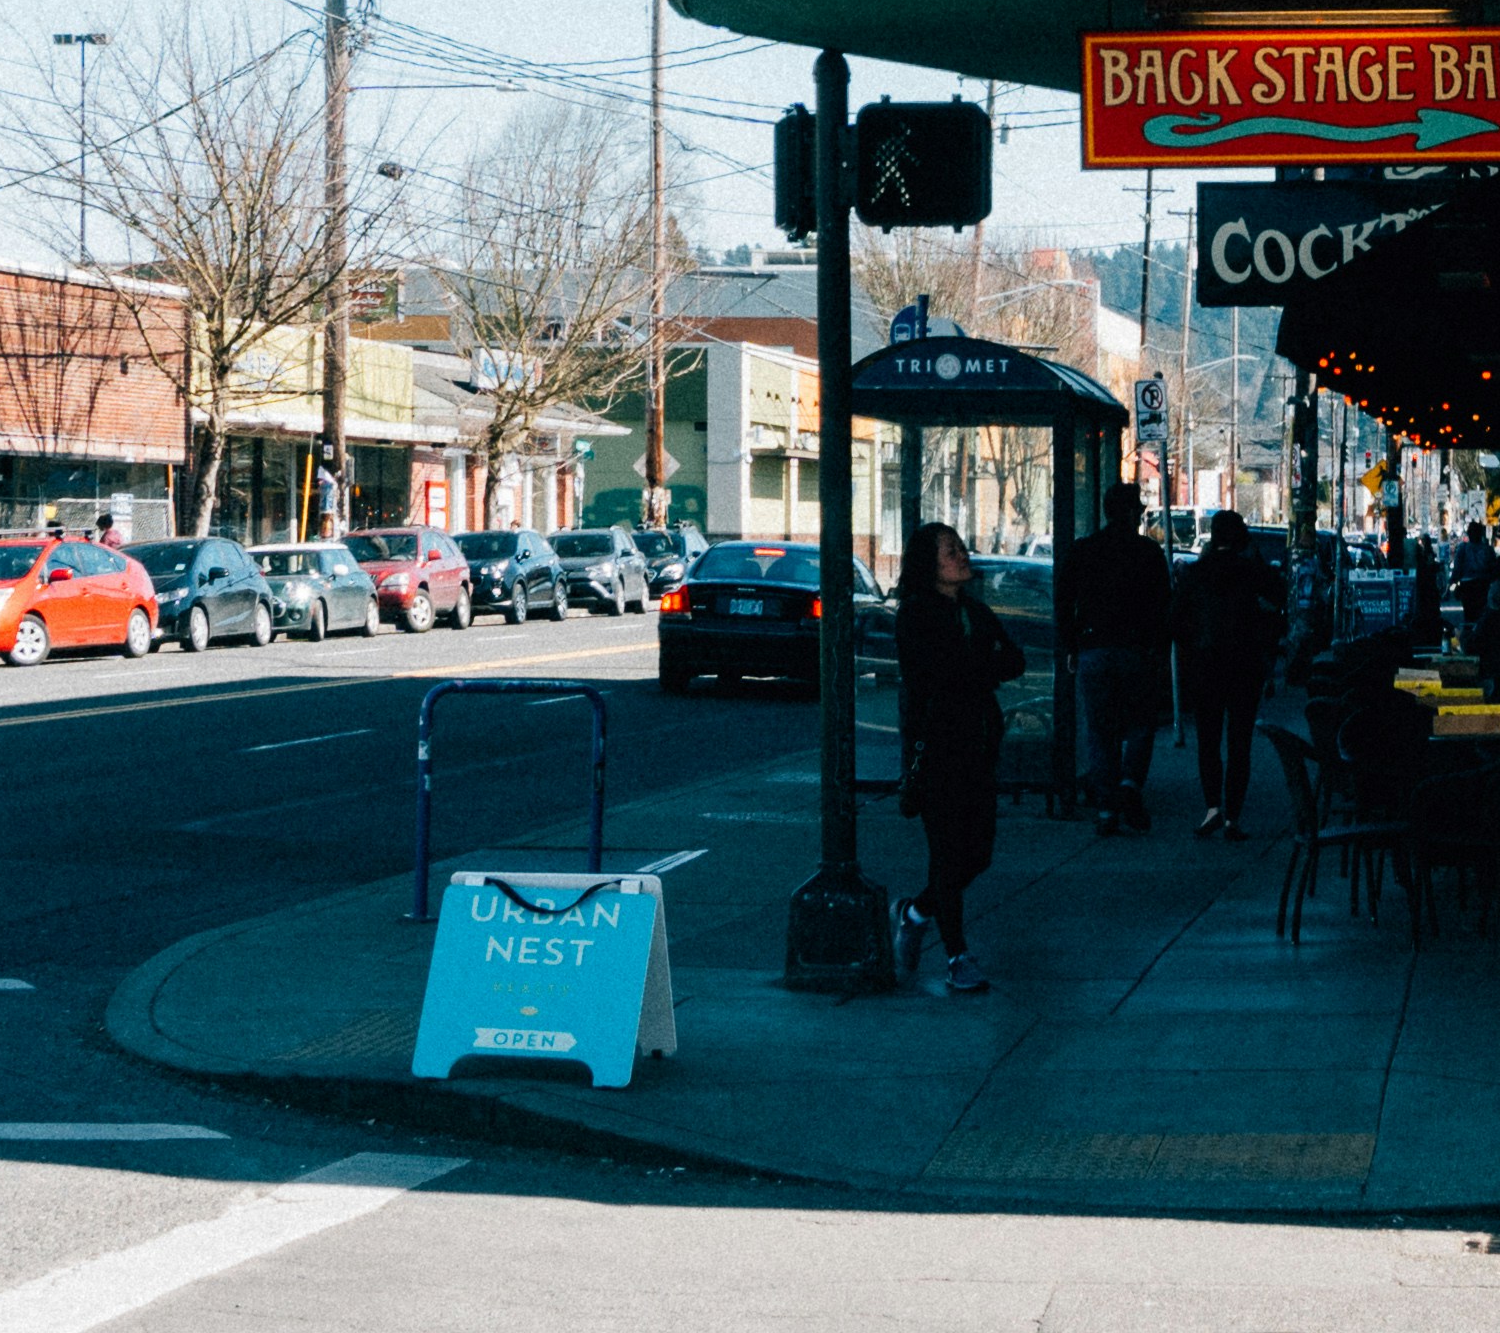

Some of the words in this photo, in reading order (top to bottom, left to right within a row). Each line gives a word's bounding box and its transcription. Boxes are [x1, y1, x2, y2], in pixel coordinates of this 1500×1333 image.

[1100, 48, 1241, 106] BACK
[1251, 46, 1414, 103] STAGE
[1211, 201, 1447, 283] COCK
[896, 359, 930, 373] TRI
[965, 359, 1008, 373] MET
[471, 895, 621, 929] URBAN
[485, 936, 594, 966] NEST
[493, 1033, 555, 1047] OPEN
